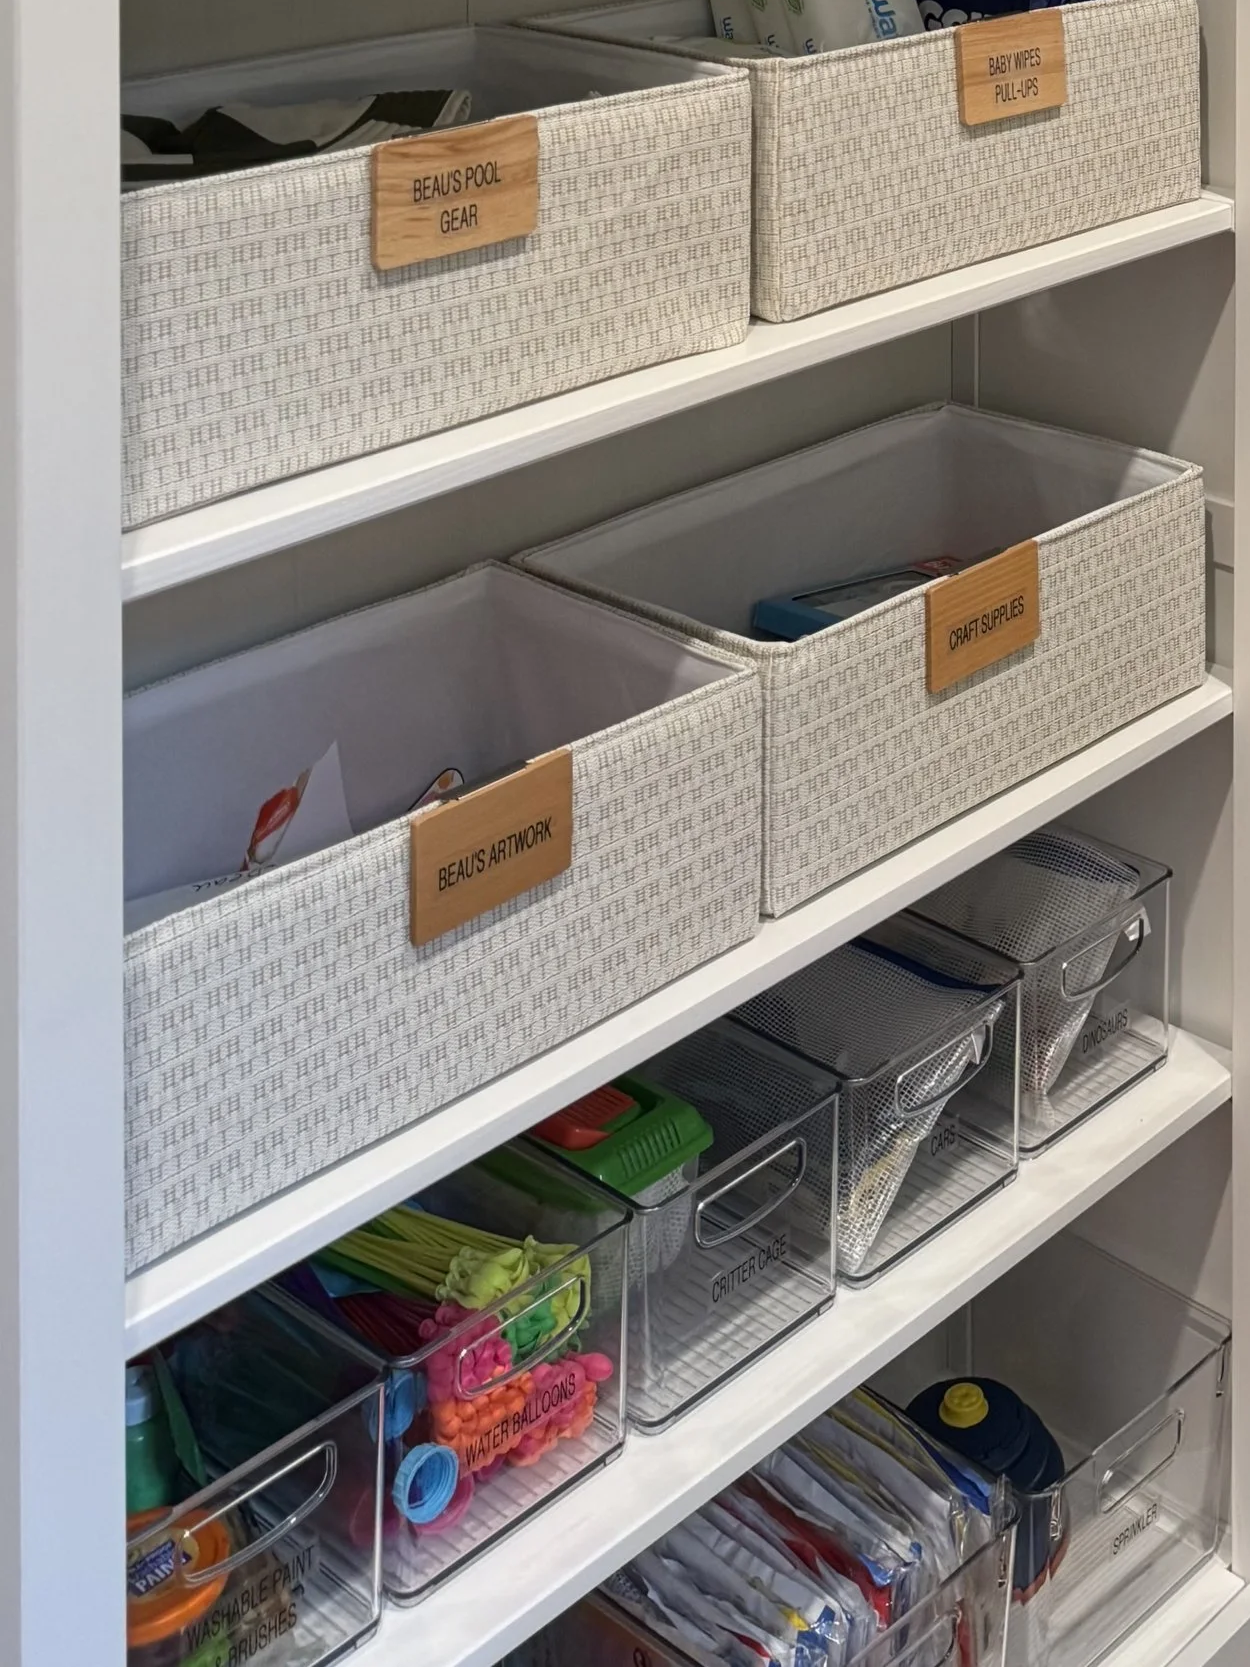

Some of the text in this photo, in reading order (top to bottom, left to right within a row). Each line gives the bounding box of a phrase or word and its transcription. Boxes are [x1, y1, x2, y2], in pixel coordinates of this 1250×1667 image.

[989, 47, 1042, 76] BABY WIPES
[995, 77, 1039, 104] PULL-UPS
[412, 159, 502, 203] BEAU'S POOL
[439, 205, 479, 234] GEAR
[949, 595, 1025, 650] CRAFT SUPPLIES
[438, 816, 552, 891] BEAU'S ARTWORK
[1082, 1008, 1129, 1055] DINOSAURS
[930, 1122, 957, 1157] CARS
[712, 1233, 787, 1303] CRITTER CAGE
[465, 1372, 576, 1467] WATER BALLOONS
[1112, 1502, 1158, 1556] SPRINKLER
[185, 1545, 315, 1653] WASHABLE PAINT
[227, 1603, 298, 1667] BRUSHES
